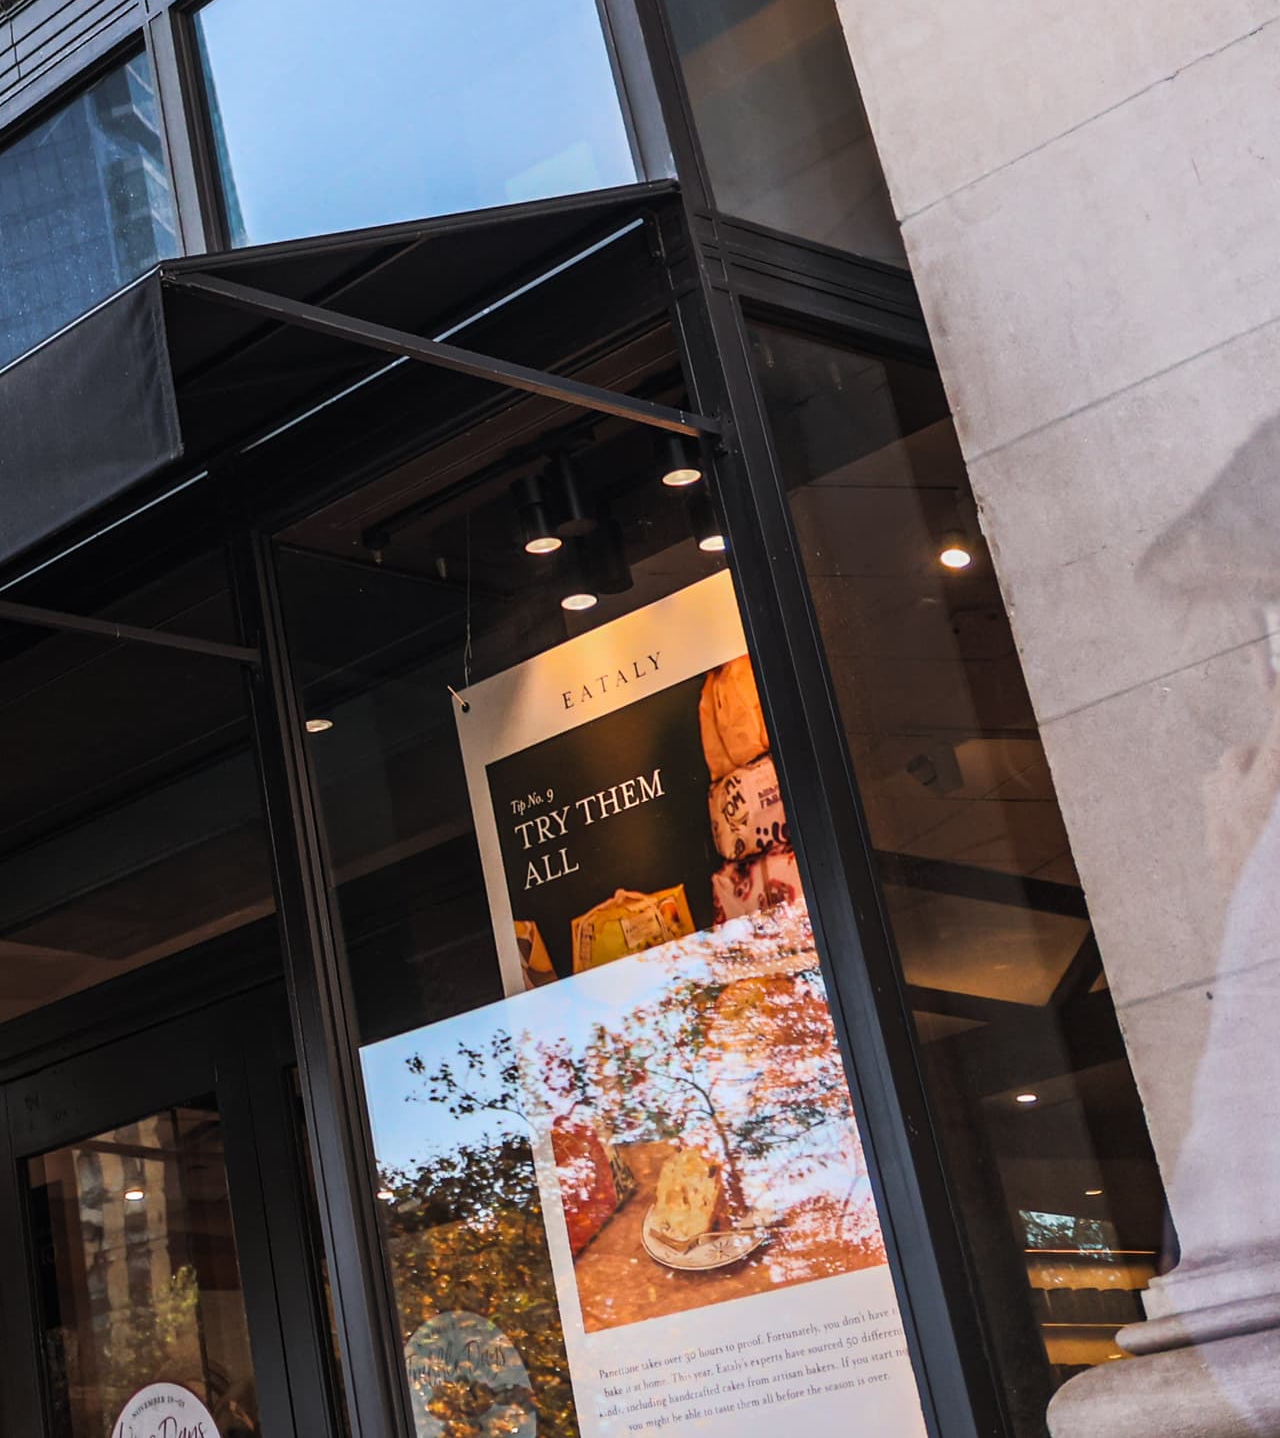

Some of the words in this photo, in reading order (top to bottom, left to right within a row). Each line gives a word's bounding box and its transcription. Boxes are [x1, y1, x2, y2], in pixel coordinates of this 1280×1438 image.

[562, 651, 660, 709] EATALY
[510, 799, 526, 816] Tip
[527, 792, 544, 808] No.
[546, 788, 554, 803] 9
[514, 805, 571, 850] TRY
[575, 768, 666, 826] THEM
[524, 847, 580, 890] ALL
[599, 1365, 639, 1379] Panettone
[641, 1358, 662, 1370] takes
[664, 1354, 681, 1366] over
[684, 1352, 696, 1362] 30
[698, 1347, 723, 1358] hours
[725, 1344, 735, 1352] to
[737, 1334, 763, 1353] proof.
[766, 1323, 820, 1343] Fortunately,
[824, 1321, 839, 1334] you
[868, 1309, 888, 1321] have
[604, 1386, 623, 1397] bake
[625, 1385, 631, 1394] it
[672, 1372, 691, 1383] This
[750, 1354, 783, 1368] experts
[784, 1348, 806, 1359] have
[808, 1338, 844, 1354] sourced
[846, 1337, 858, 1348] 50
[627, 1397, 667, 1413] including
[668, 1383, 720, 1403] handcrafted
[722, 1380, 744, 1392] cakes
[747, 1376, 769, 1387] from
[772, 1370, 804, 1382] artisan
[805, 1363, 839, 1375] bakers.
[841, 1356, 849, 1368] If
[852, 1356, 868, 1369] you
[871, 1350, 893, 1361] start
[629, 1423, 643, 1434] you
[646, 1414, 670, 1428] might
[672, 1412, 682, 1422] be
[685, 1408, 700, 1420] able
[704, 1408, 713, 1416] to
[714, 1404, 735, 1414] taste
[737, 1398, 760, 1409] them
[762, 1393, 774, 1404] all
[775, 1389, 805, 1402] before
[807, 1384, 822, 1395] the
[825, 1380, 855, 1391] season
[857, 1378, 865, 1386] is
[868, 1373, 890, 1384] over.
